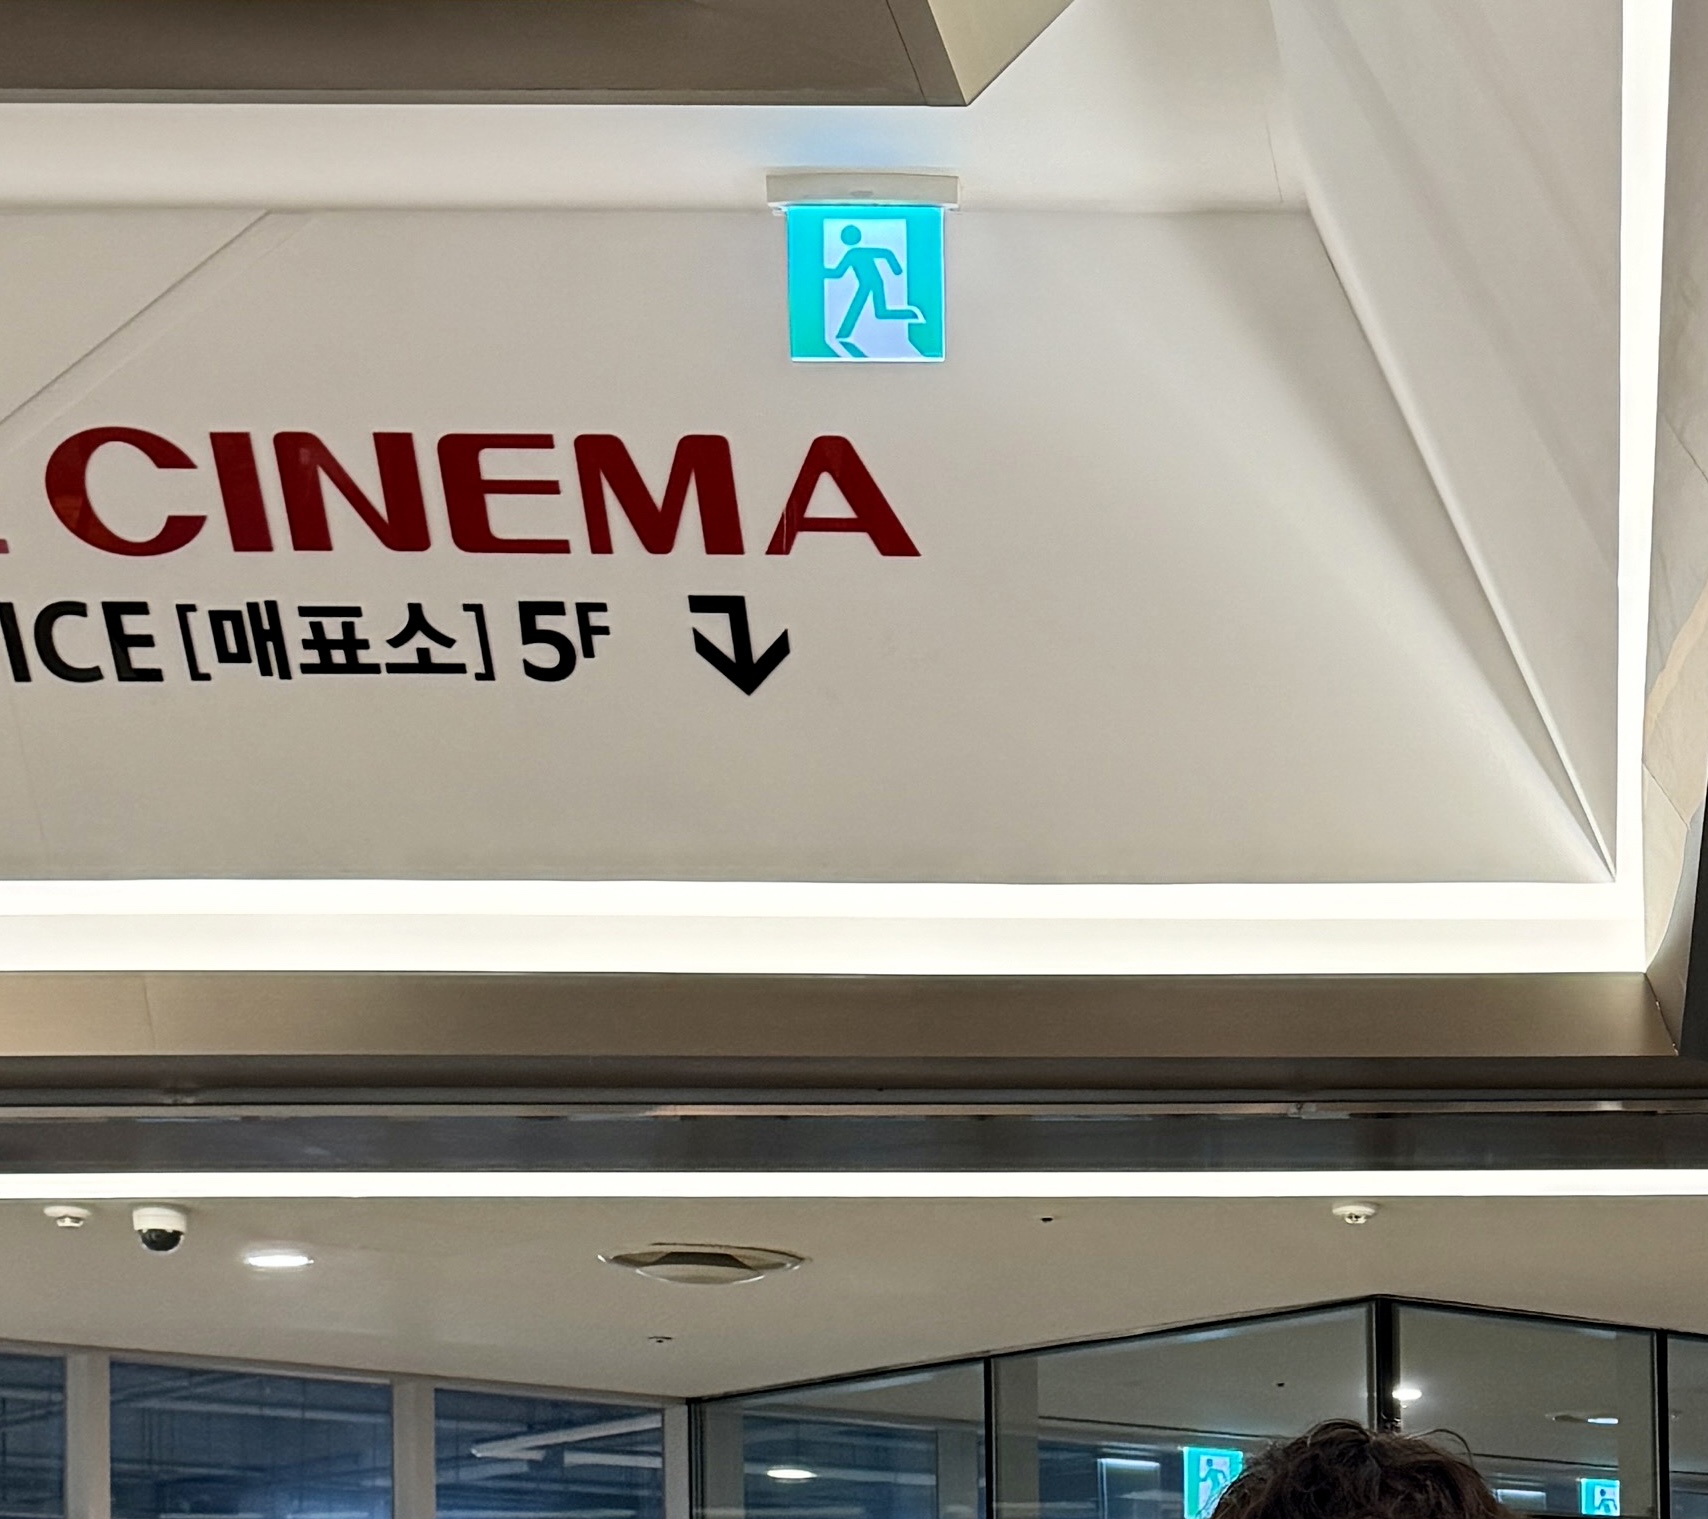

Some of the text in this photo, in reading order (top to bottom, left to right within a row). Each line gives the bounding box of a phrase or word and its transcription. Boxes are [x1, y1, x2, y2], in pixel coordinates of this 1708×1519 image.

[45, 426, 920, 557] CINEMA
[0, 600, 610, 682] ICE [매표소] 5F
